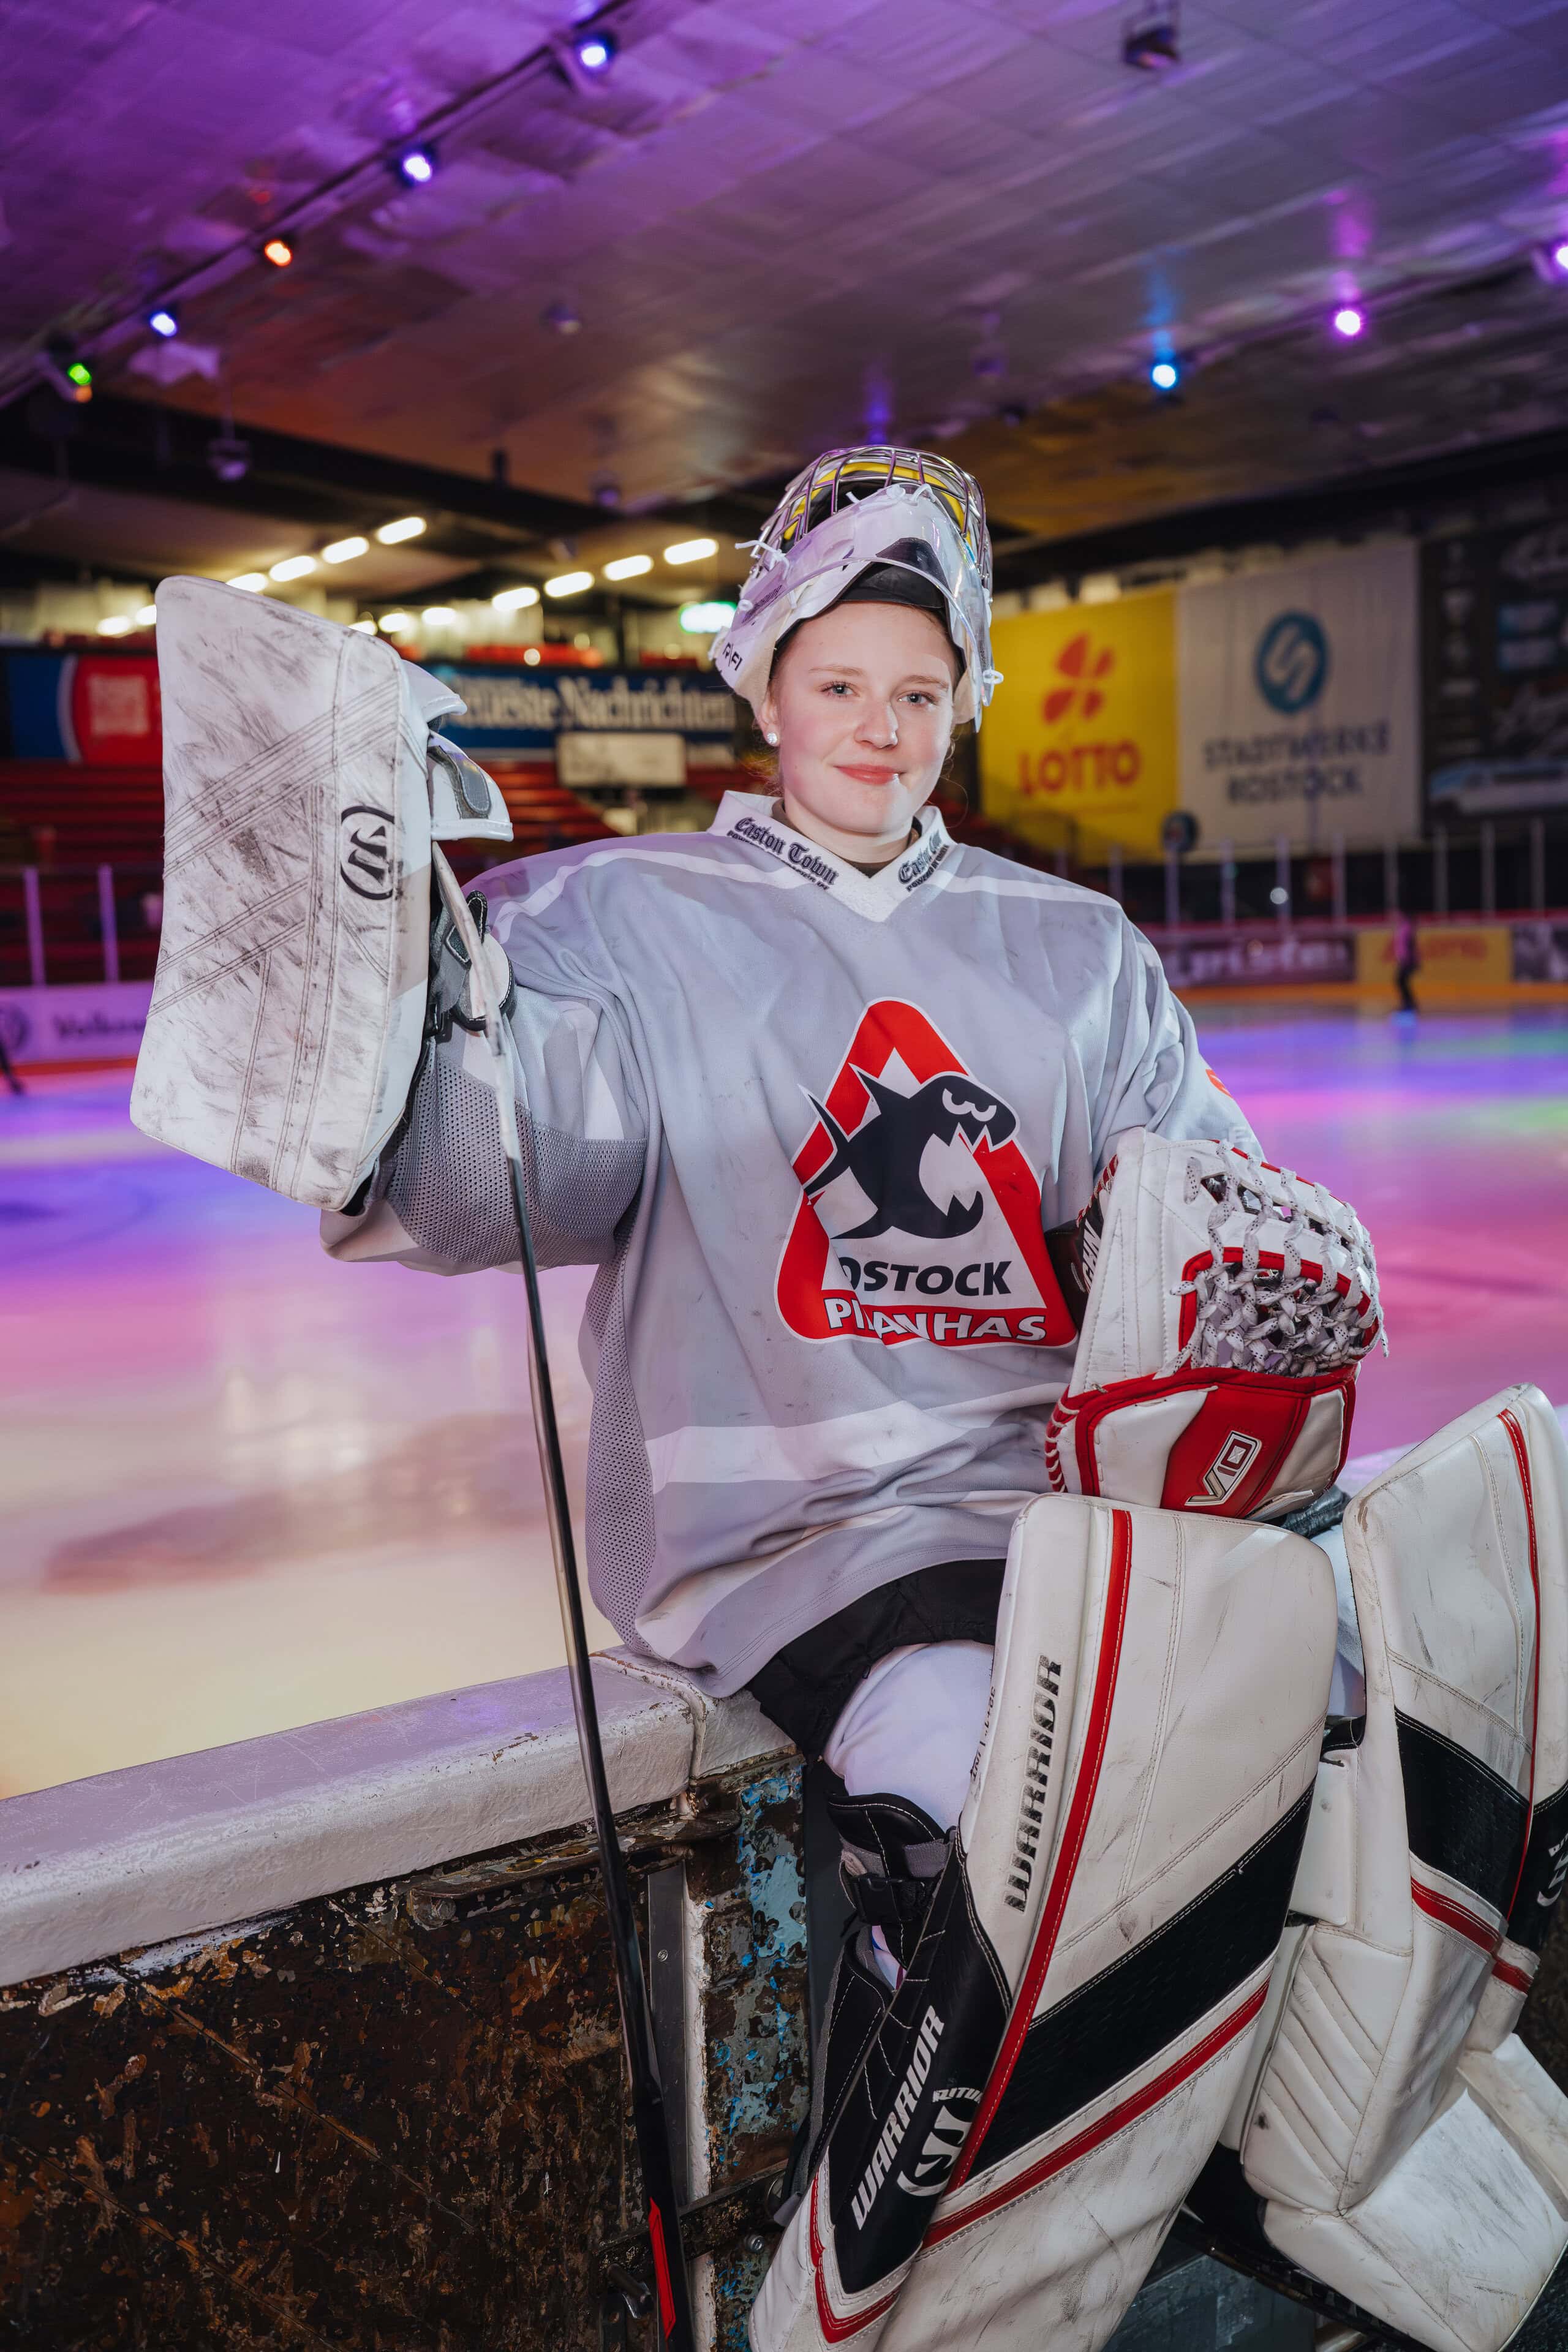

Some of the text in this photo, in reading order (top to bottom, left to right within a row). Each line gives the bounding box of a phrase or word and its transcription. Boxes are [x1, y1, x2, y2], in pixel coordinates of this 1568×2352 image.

[1019, 739, 1142, 799] LOTTO
[734, 816, 786, 855] Easton
[788, 842, 839, 885] Town
[837, 1256, 1012, 1297] OSTOCK
[824, 1297, 1047, 1341] PIANHAS
[1004, 1654, 1061, 1913] WARRIOR
[850, 2005, 945, 2230] WARRIOR
